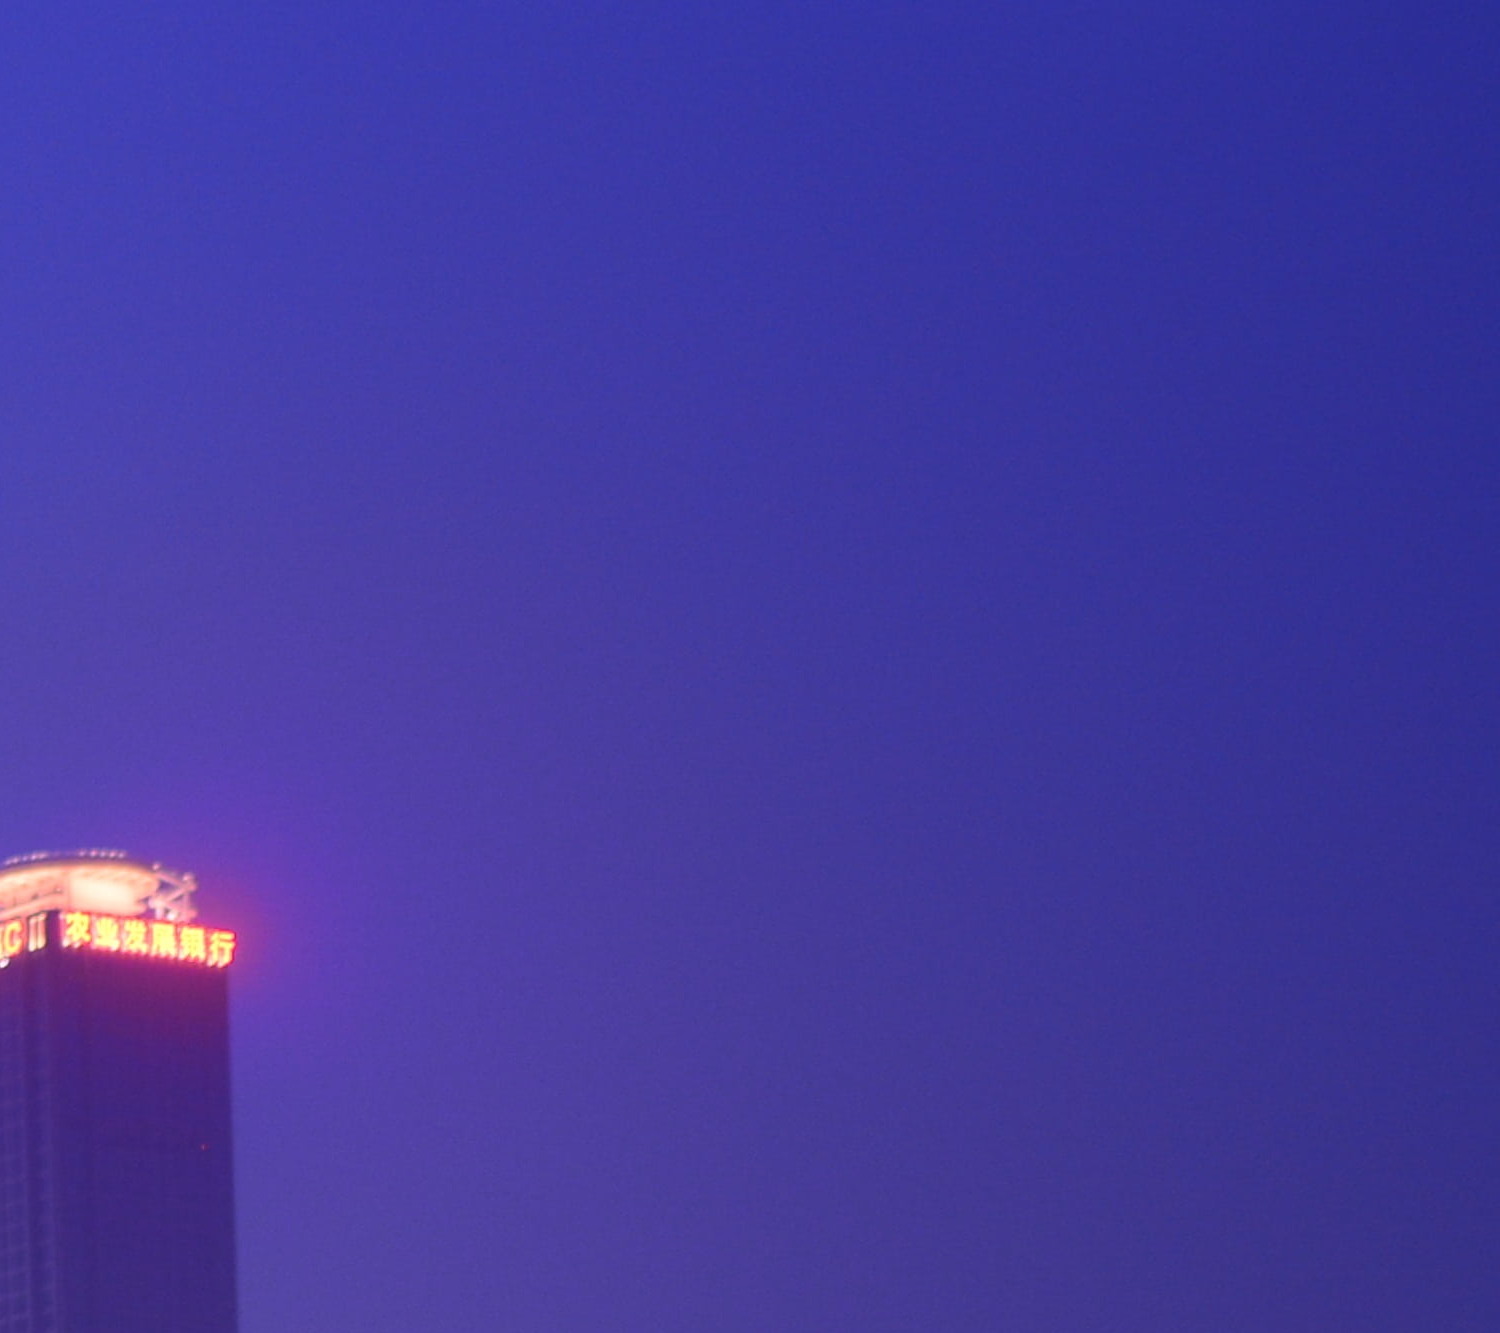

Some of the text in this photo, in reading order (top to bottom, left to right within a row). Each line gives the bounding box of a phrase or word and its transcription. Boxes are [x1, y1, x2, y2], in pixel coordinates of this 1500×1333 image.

[64, 912, 236, 968] 农业发展银行
